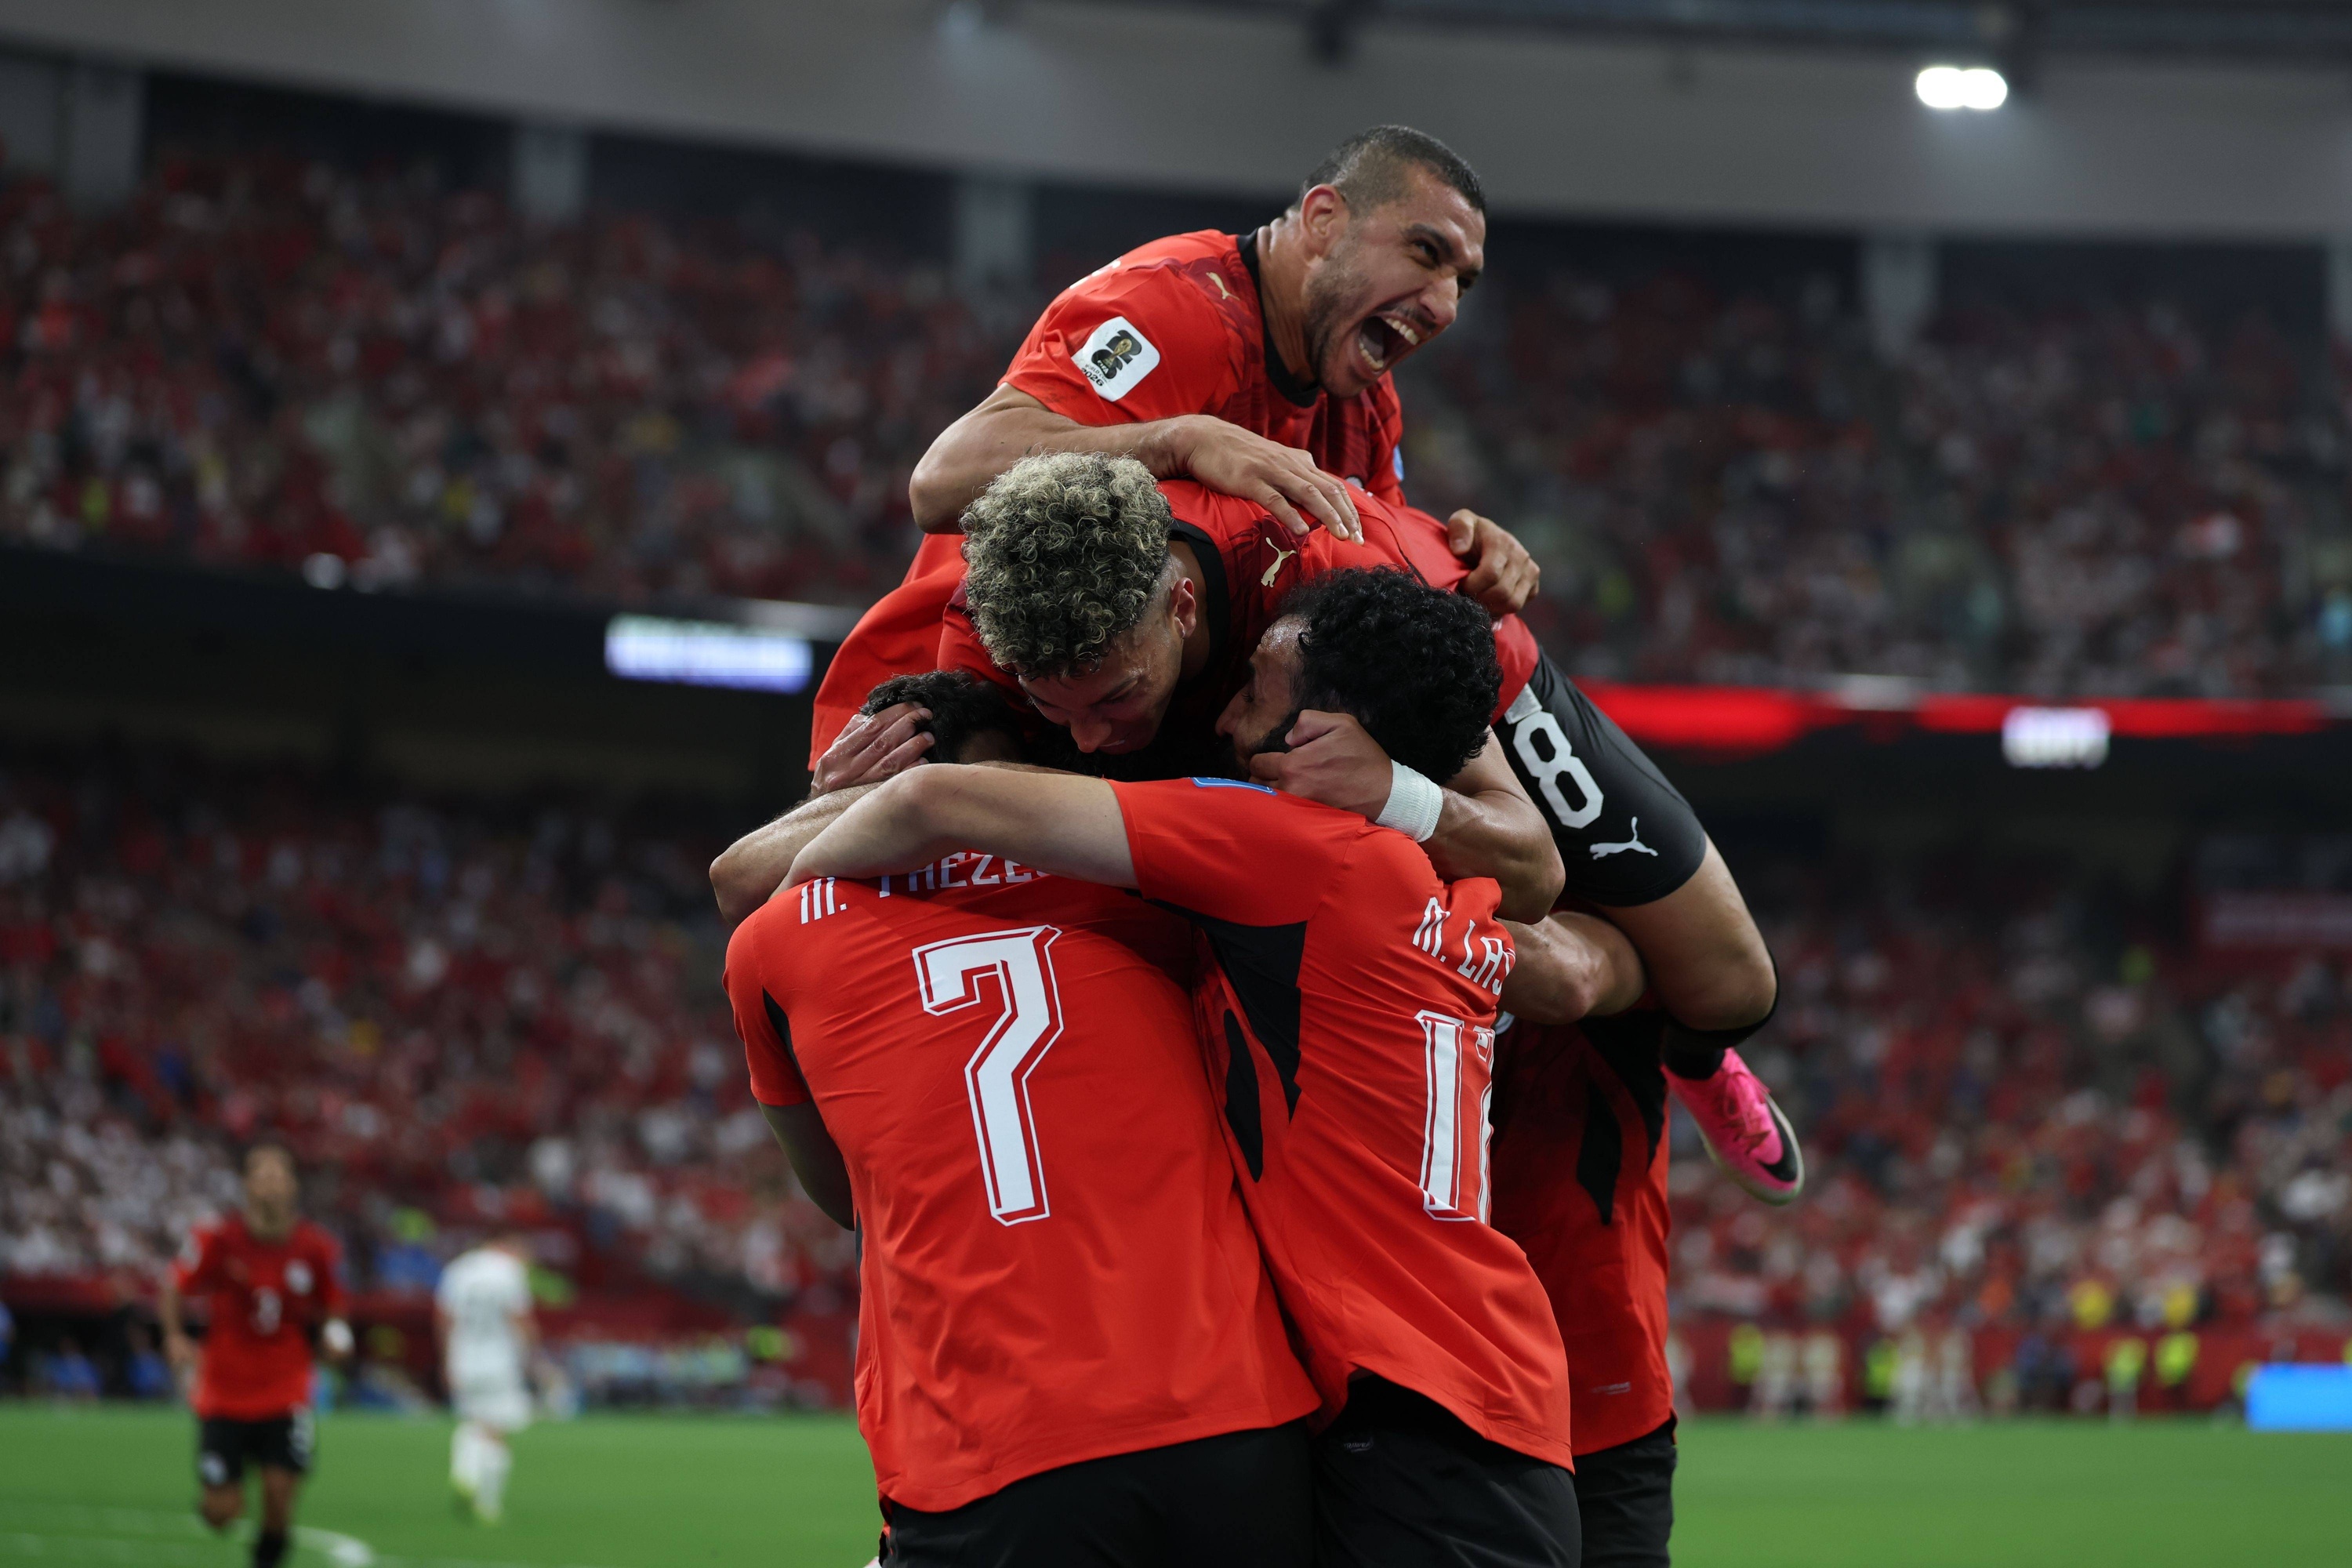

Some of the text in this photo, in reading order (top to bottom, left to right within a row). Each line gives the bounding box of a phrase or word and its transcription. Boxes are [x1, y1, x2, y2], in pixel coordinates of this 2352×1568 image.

[1081, 367, 1105, 387] 2026
[1097, 359, 1109, 375] FIFA
[1513, 711, 1604, 829] 8
[1412, 897, 1450, 963] M.
[912, 924, 1064, 1227] 7
